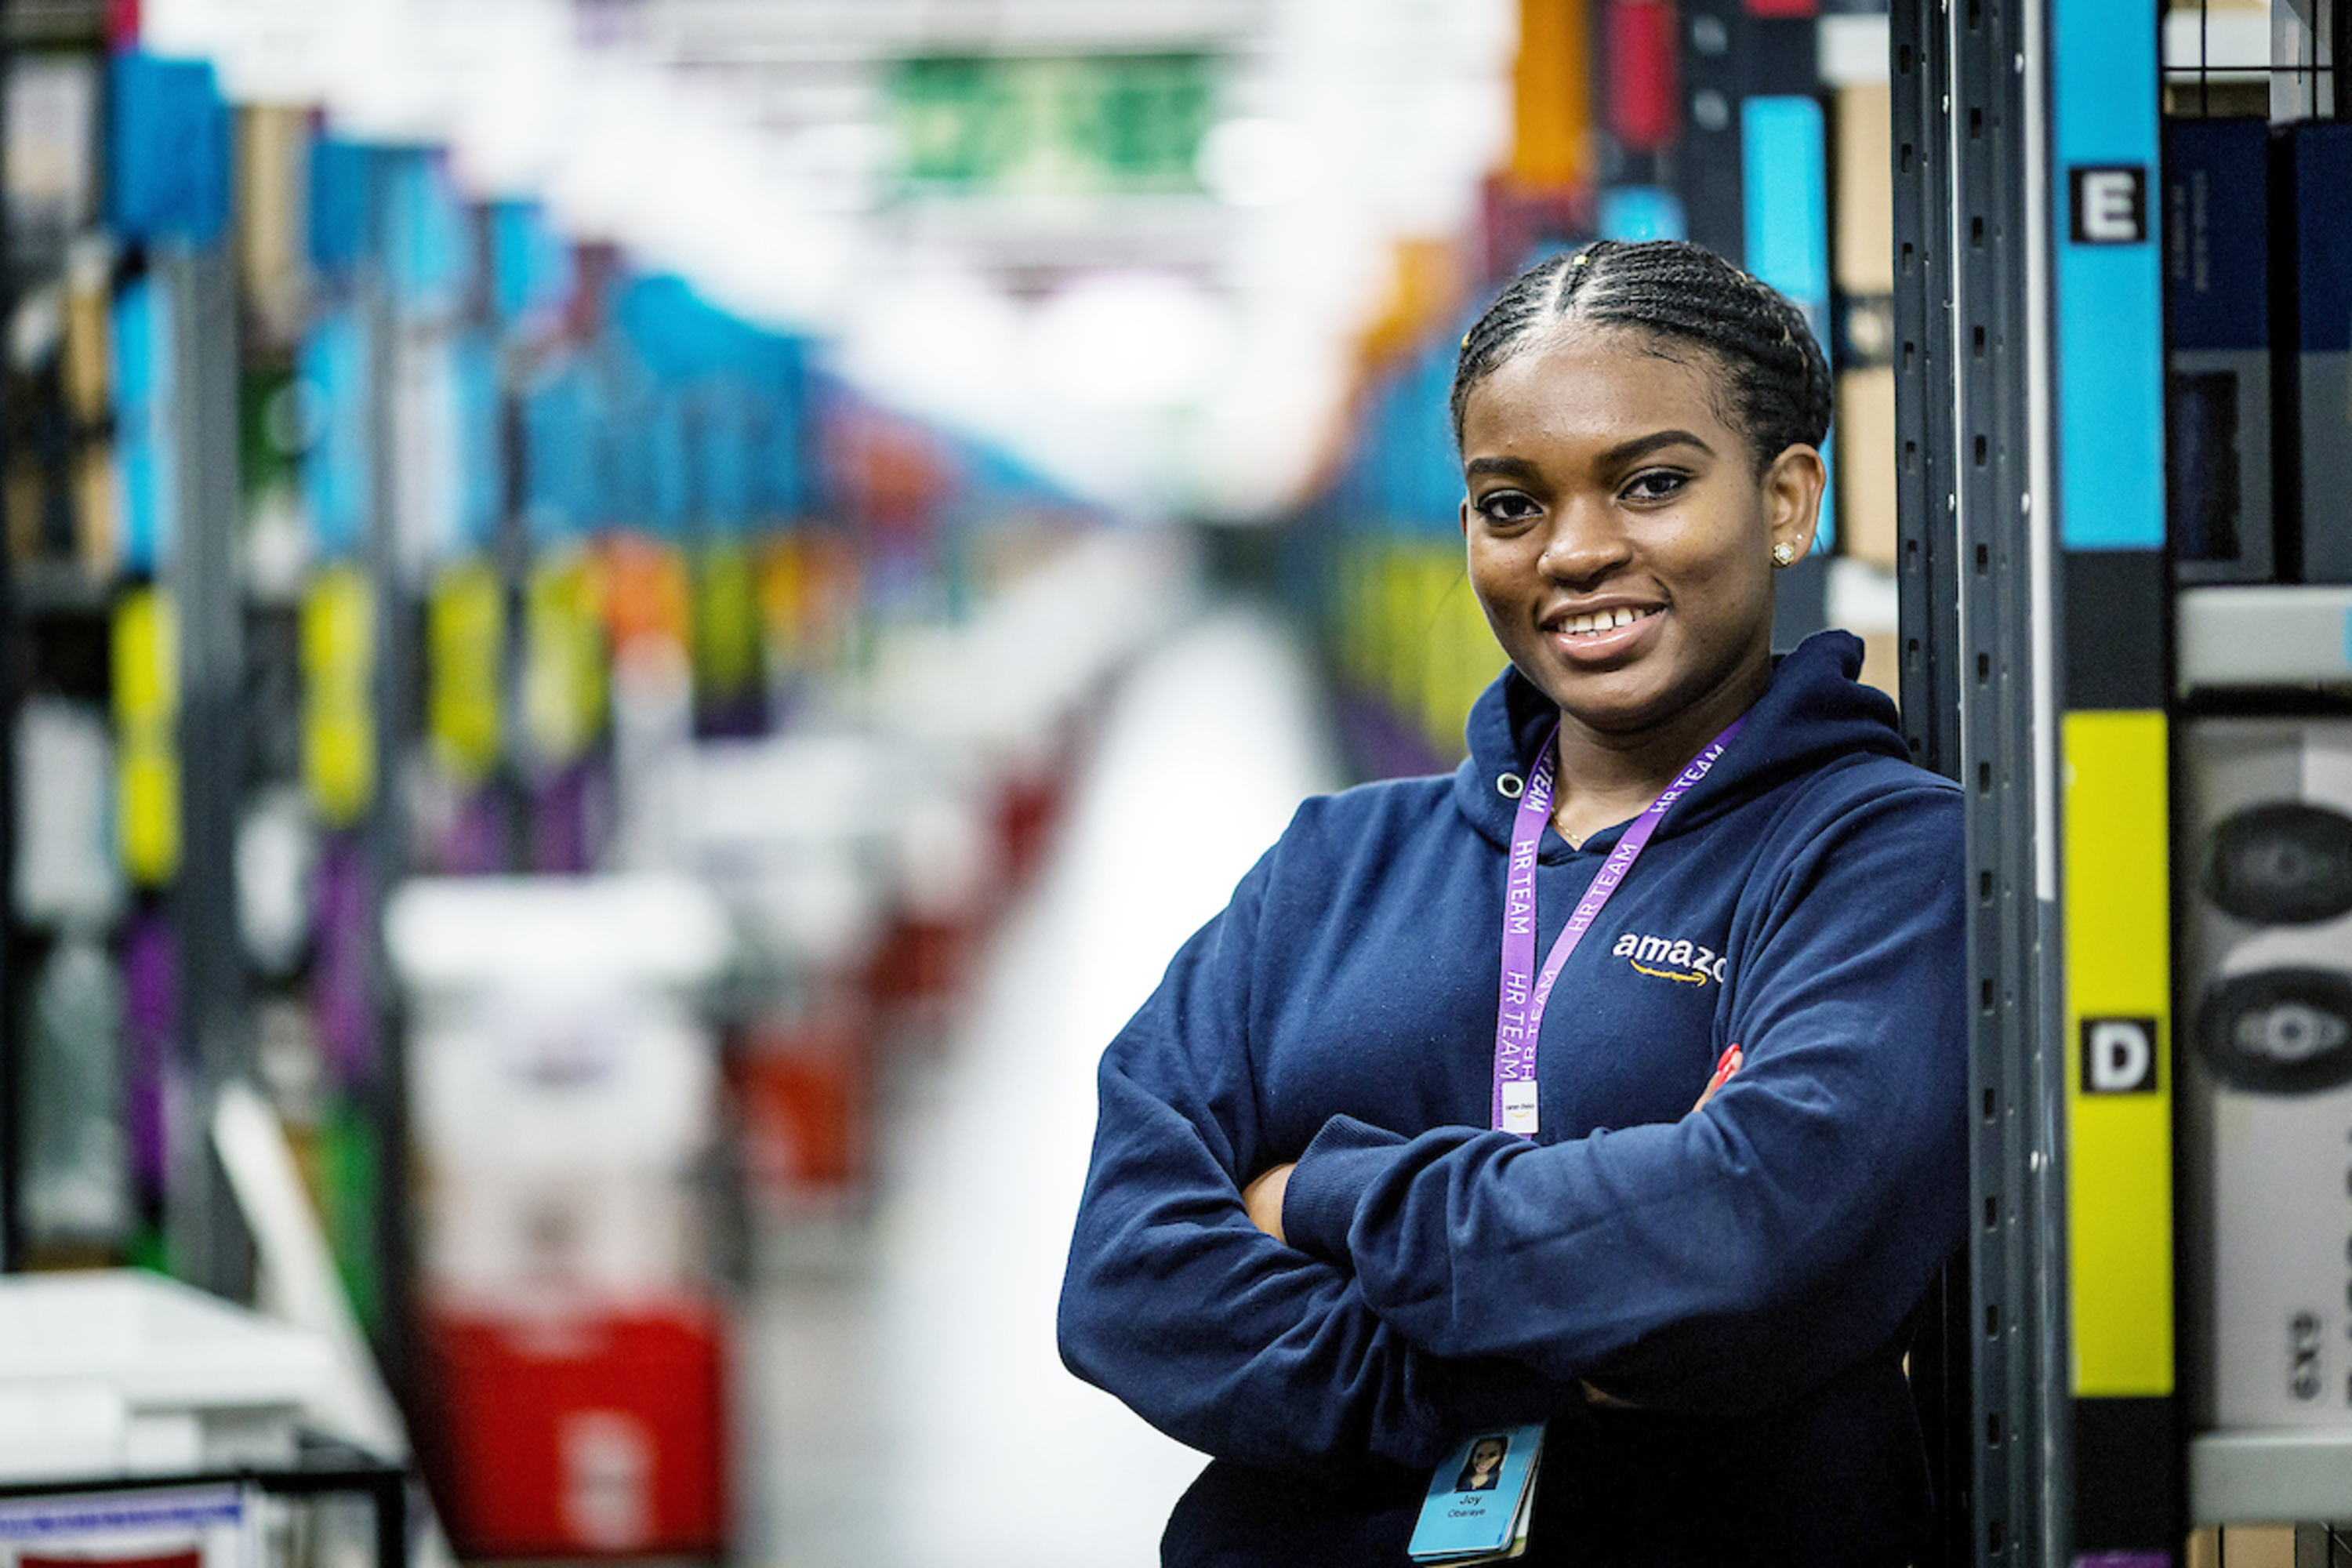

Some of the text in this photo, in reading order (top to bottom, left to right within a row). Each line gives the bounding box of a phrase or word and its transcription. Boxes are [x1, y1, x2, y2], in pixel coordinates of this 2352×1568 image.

[2082, 172, 2138, 240] E
[1524, 765, 1554, 814] TEAM
[1650, 743, 1725, 813] HR TEAM
[1508, 840, 1536, 935] HR TEAM
[1568, 844, 1638, 931] HR TEAM
[1505, 971, 1528, 1005] HR
[1526, 970, 1558, 1040] TEAM
[1499, 1011, 1526, 1080] TEAM
[1519, 1046, 1535, 1081] HR
[2090, 1022, 2150, 1091] D
[1459, 1494, 1483, 1507] Joy
